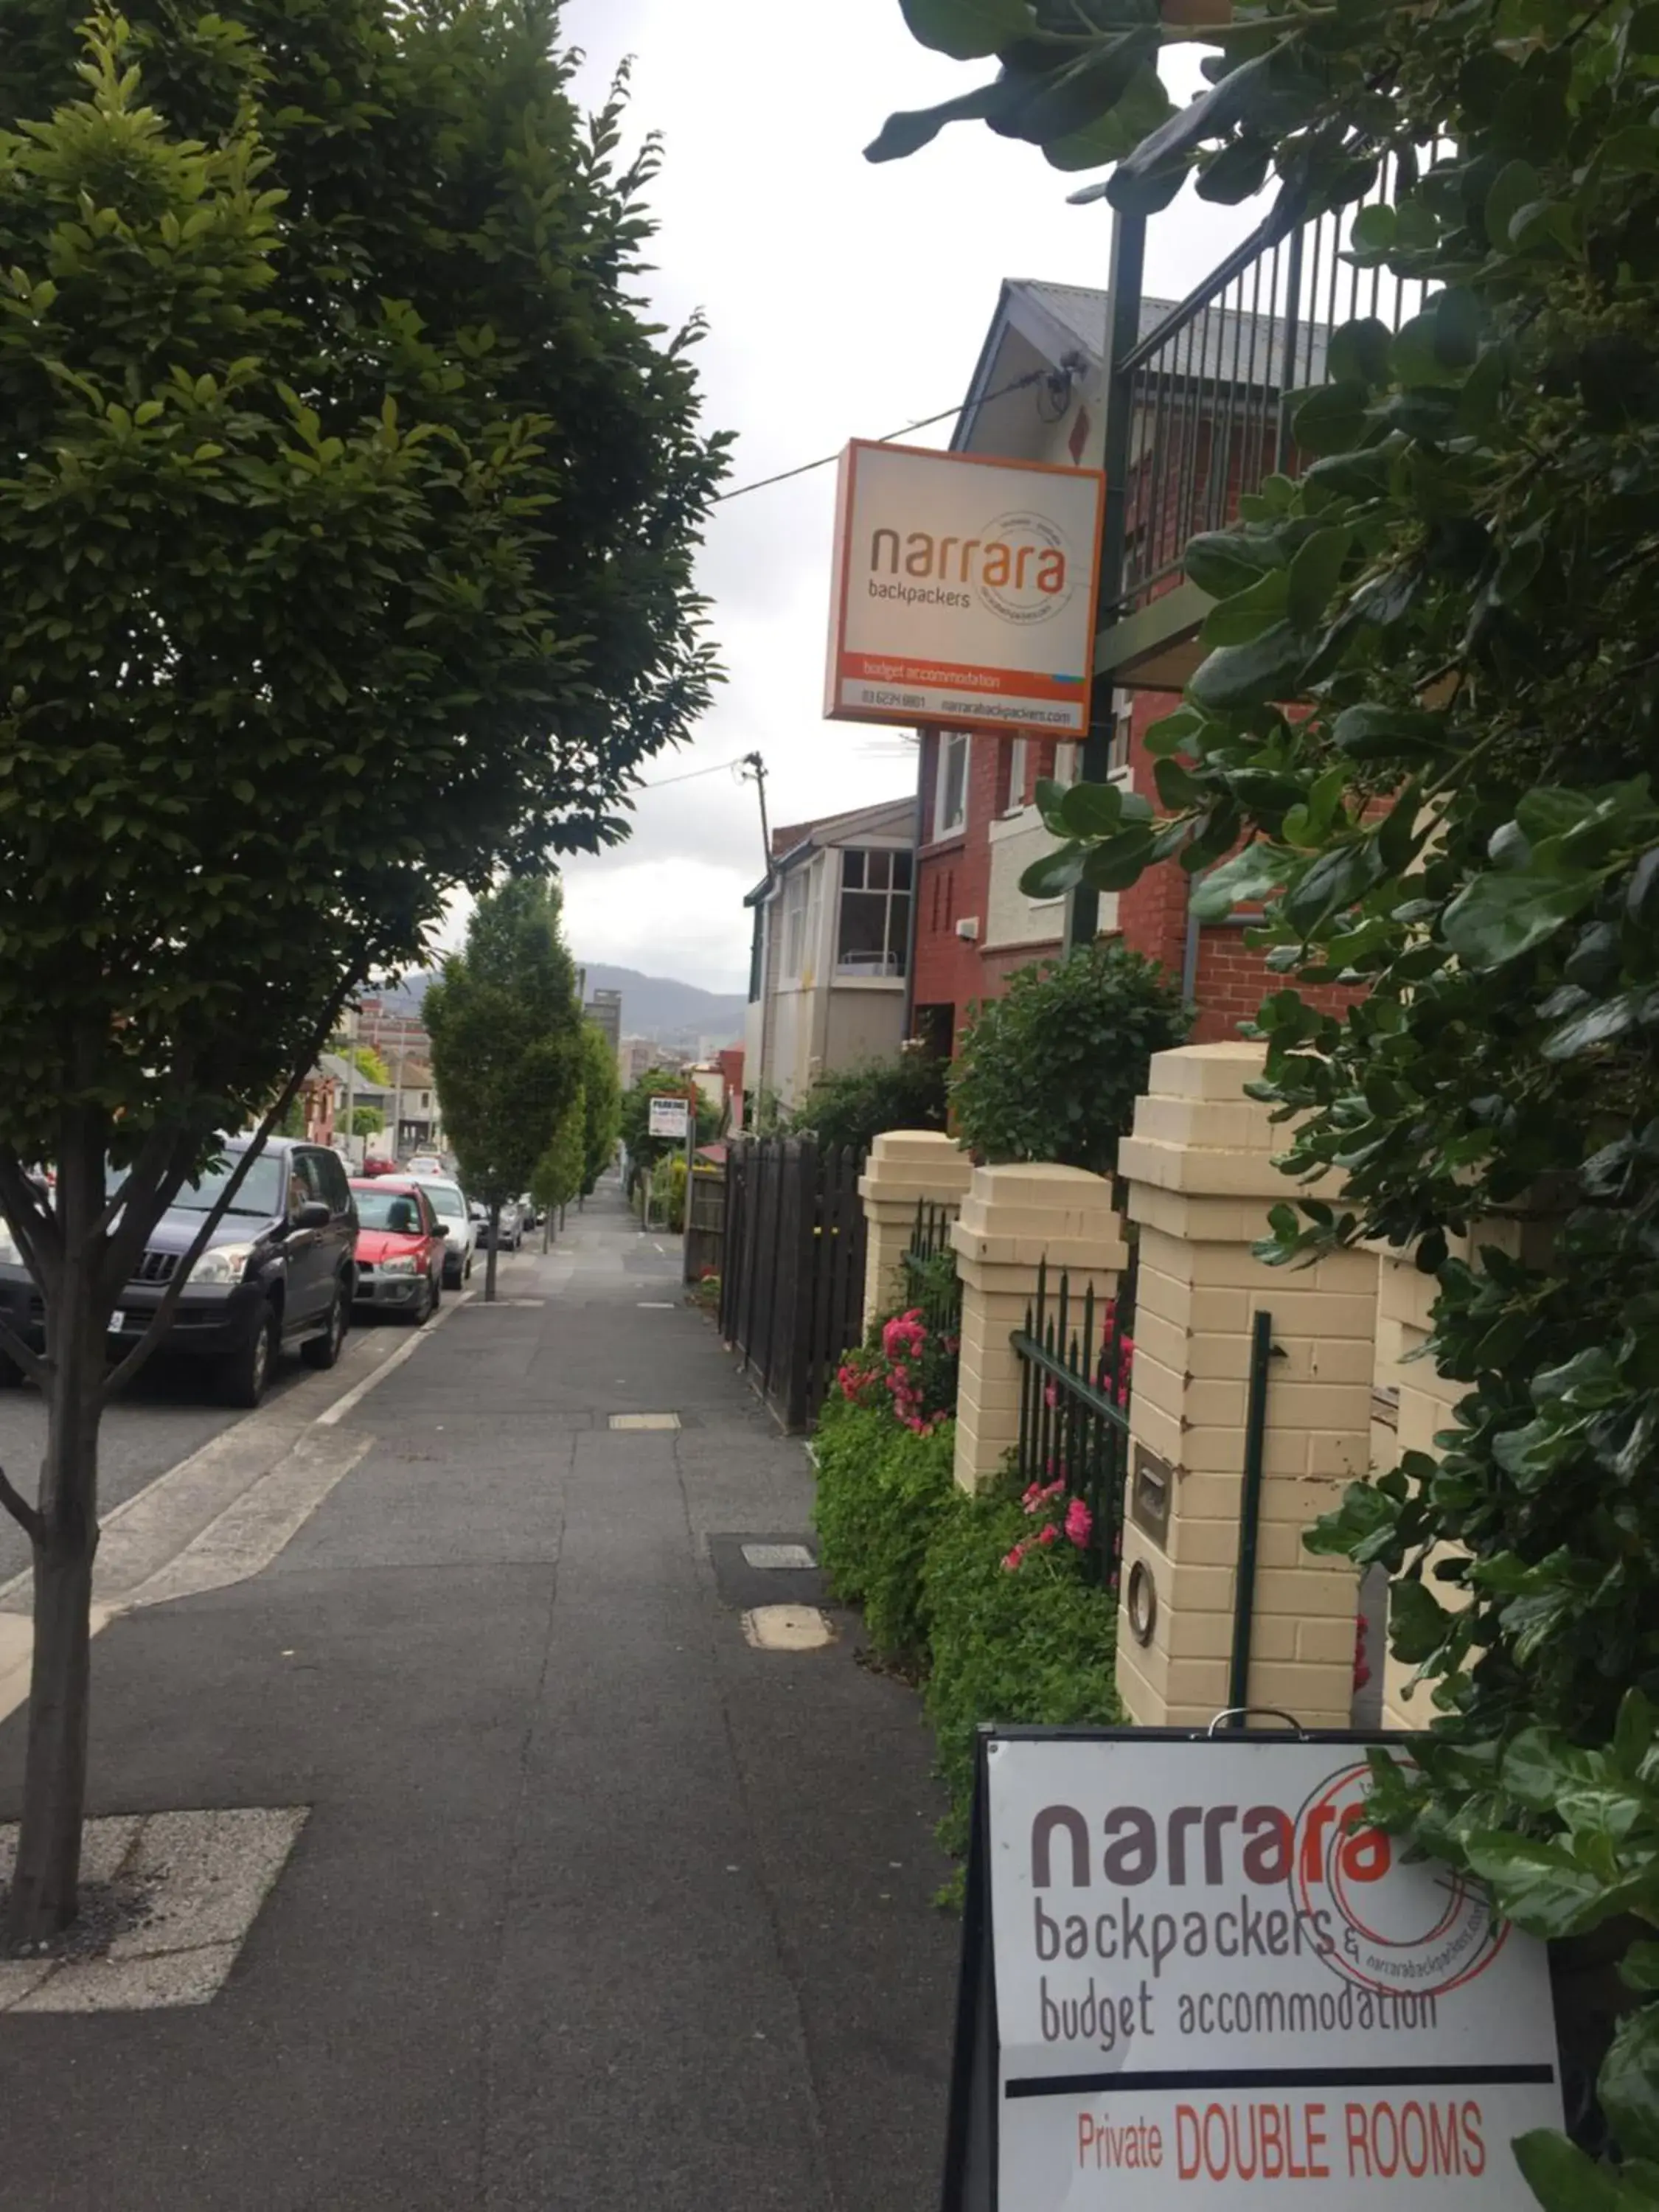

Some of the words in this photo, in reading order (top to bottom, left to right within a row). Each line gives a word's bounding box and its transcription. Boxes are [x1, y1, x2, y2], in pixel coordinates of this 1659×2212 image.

[868, 579, 971, 609] backpackers
[870, 528, 1066, 594] narrara
[864, 661, 905, 681] budget
[905, 667, 1001, 688] accommodation
[1032, 1802, 1391, 1888] narrara
[1034, 1893, 1335, 1978] backpackers
[1040, 1975, 1155, 2053] budget
[1178, 1979, 1437, 2034] accommodation
[1077, 2112, 1164, 2169] Private
[1175, 2102, 1331, 2182] DOUBLE
[1344, 2099, 1486, 2179] ROOMS
